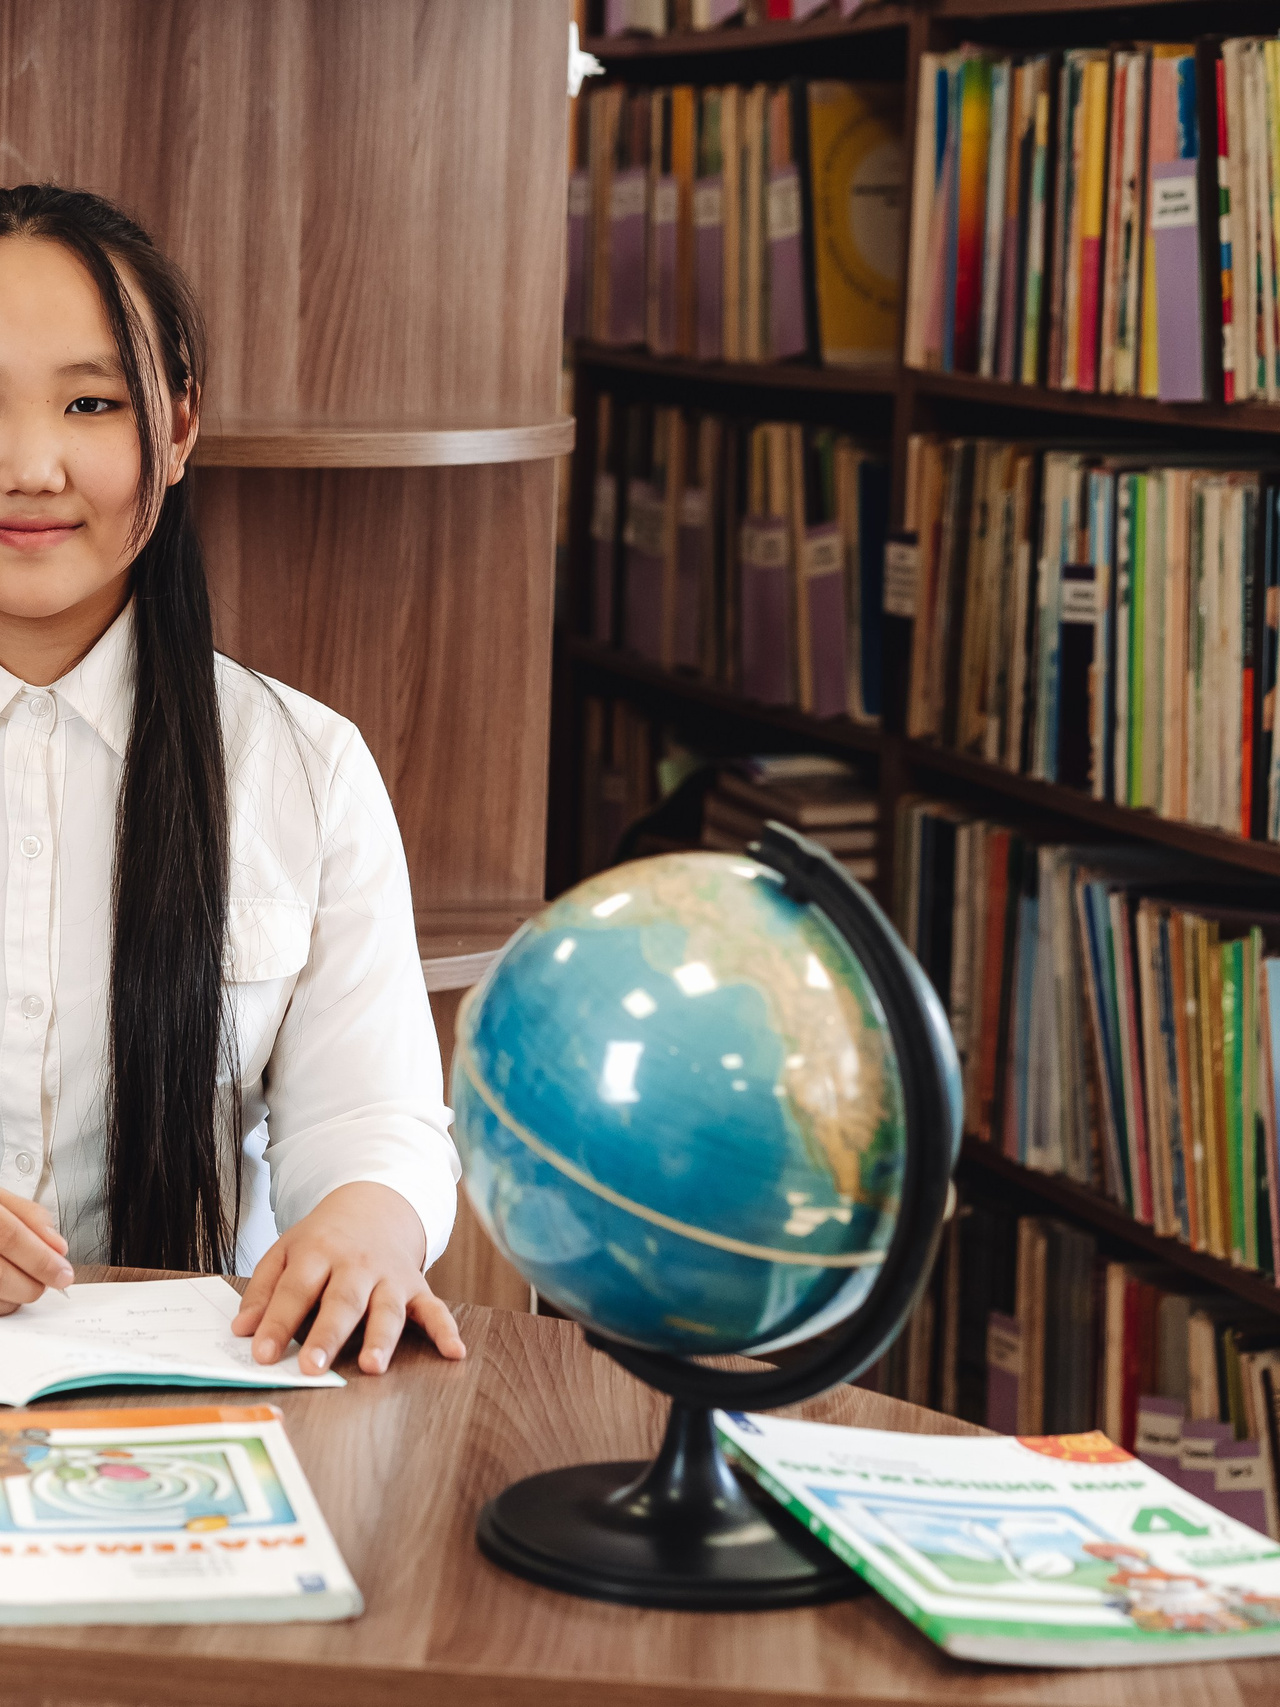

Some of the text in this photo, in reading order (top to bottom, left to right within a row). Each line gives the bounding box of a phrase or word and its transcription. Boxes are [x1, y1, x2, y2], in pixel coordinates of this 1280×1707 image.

[778, 1459, 1057, 1493] ОКРУЖАЮЩИЙ
[1070, 1479, 1148, 1494] МИР
[1131, 1506, 1209, 1537] 4
